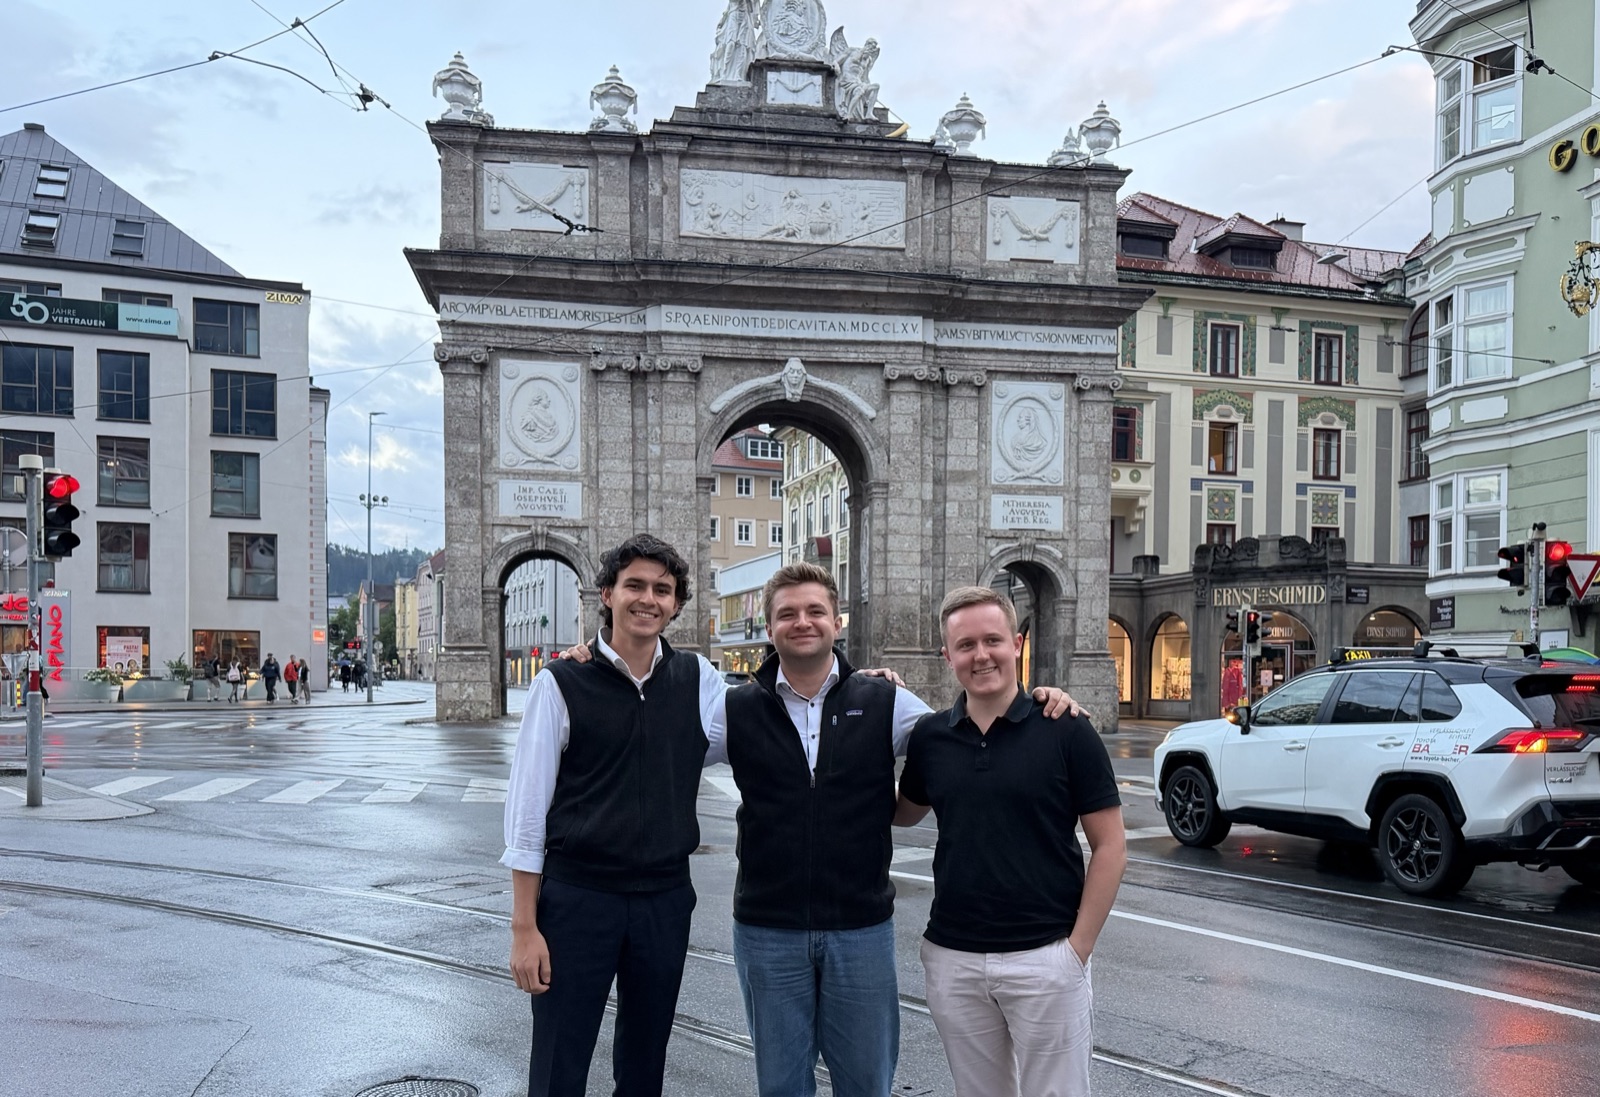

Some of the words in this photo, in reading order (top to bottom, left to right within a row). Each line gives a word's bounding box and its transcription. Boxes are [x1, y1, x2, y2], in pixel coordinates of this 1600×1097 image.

[266, 291, 303, 304] ZIMA
[10, 292, 49, 325] 50
[52, 308, 77, 317] JAHRE
[52, 316, 106, 328] VERTRAUEN
[125, 315, 171, 326] www.zima.at
[1213, 587, 1259, 606] ERNST
[1269, 584, 1325, 604] SCHMID
